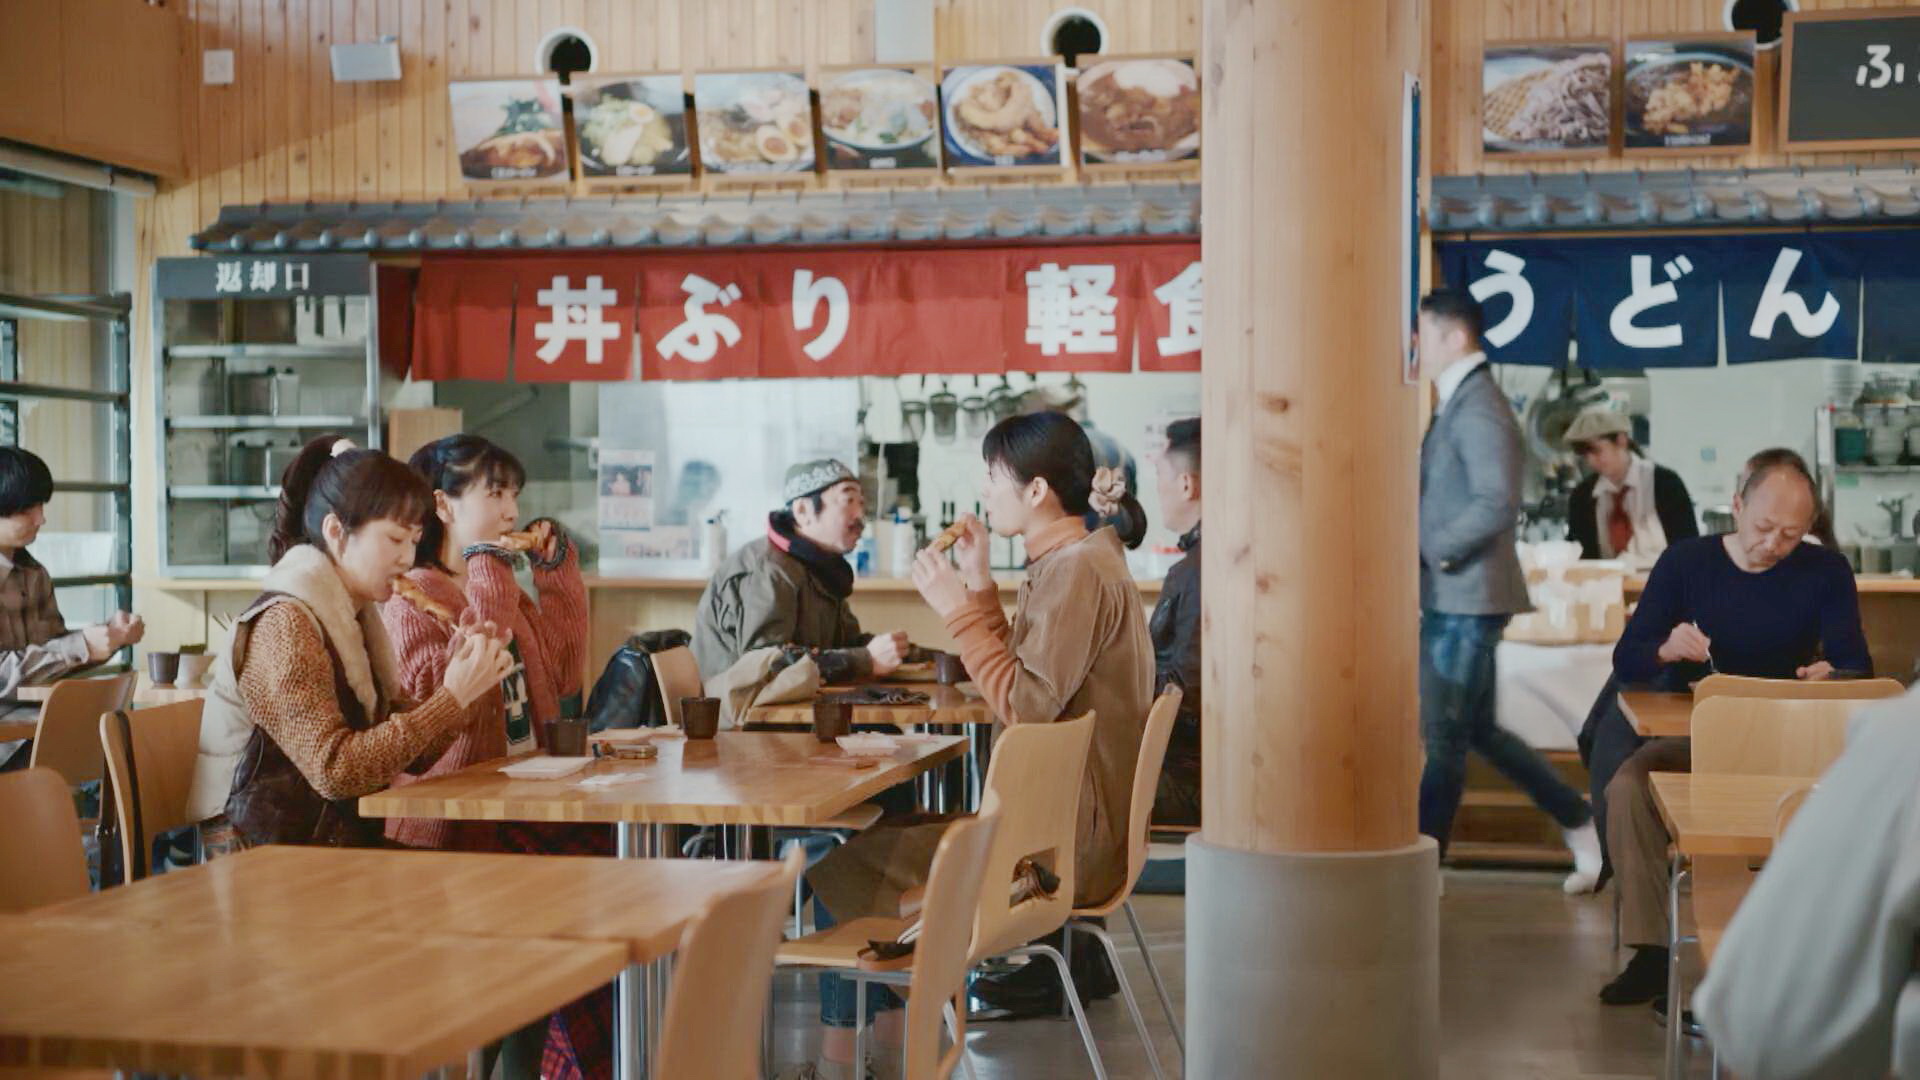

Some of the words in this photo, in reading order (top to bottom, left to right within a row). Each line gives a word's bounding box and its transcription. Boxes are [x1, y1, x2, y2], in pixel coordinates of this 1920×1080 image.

[1856, 44, 1920, 88] ふ
[215, 260, 309, 292] 返却口
[1469, 247, 1840, 348] うどん
[534, 269, 850, 364] 丼ぶり
